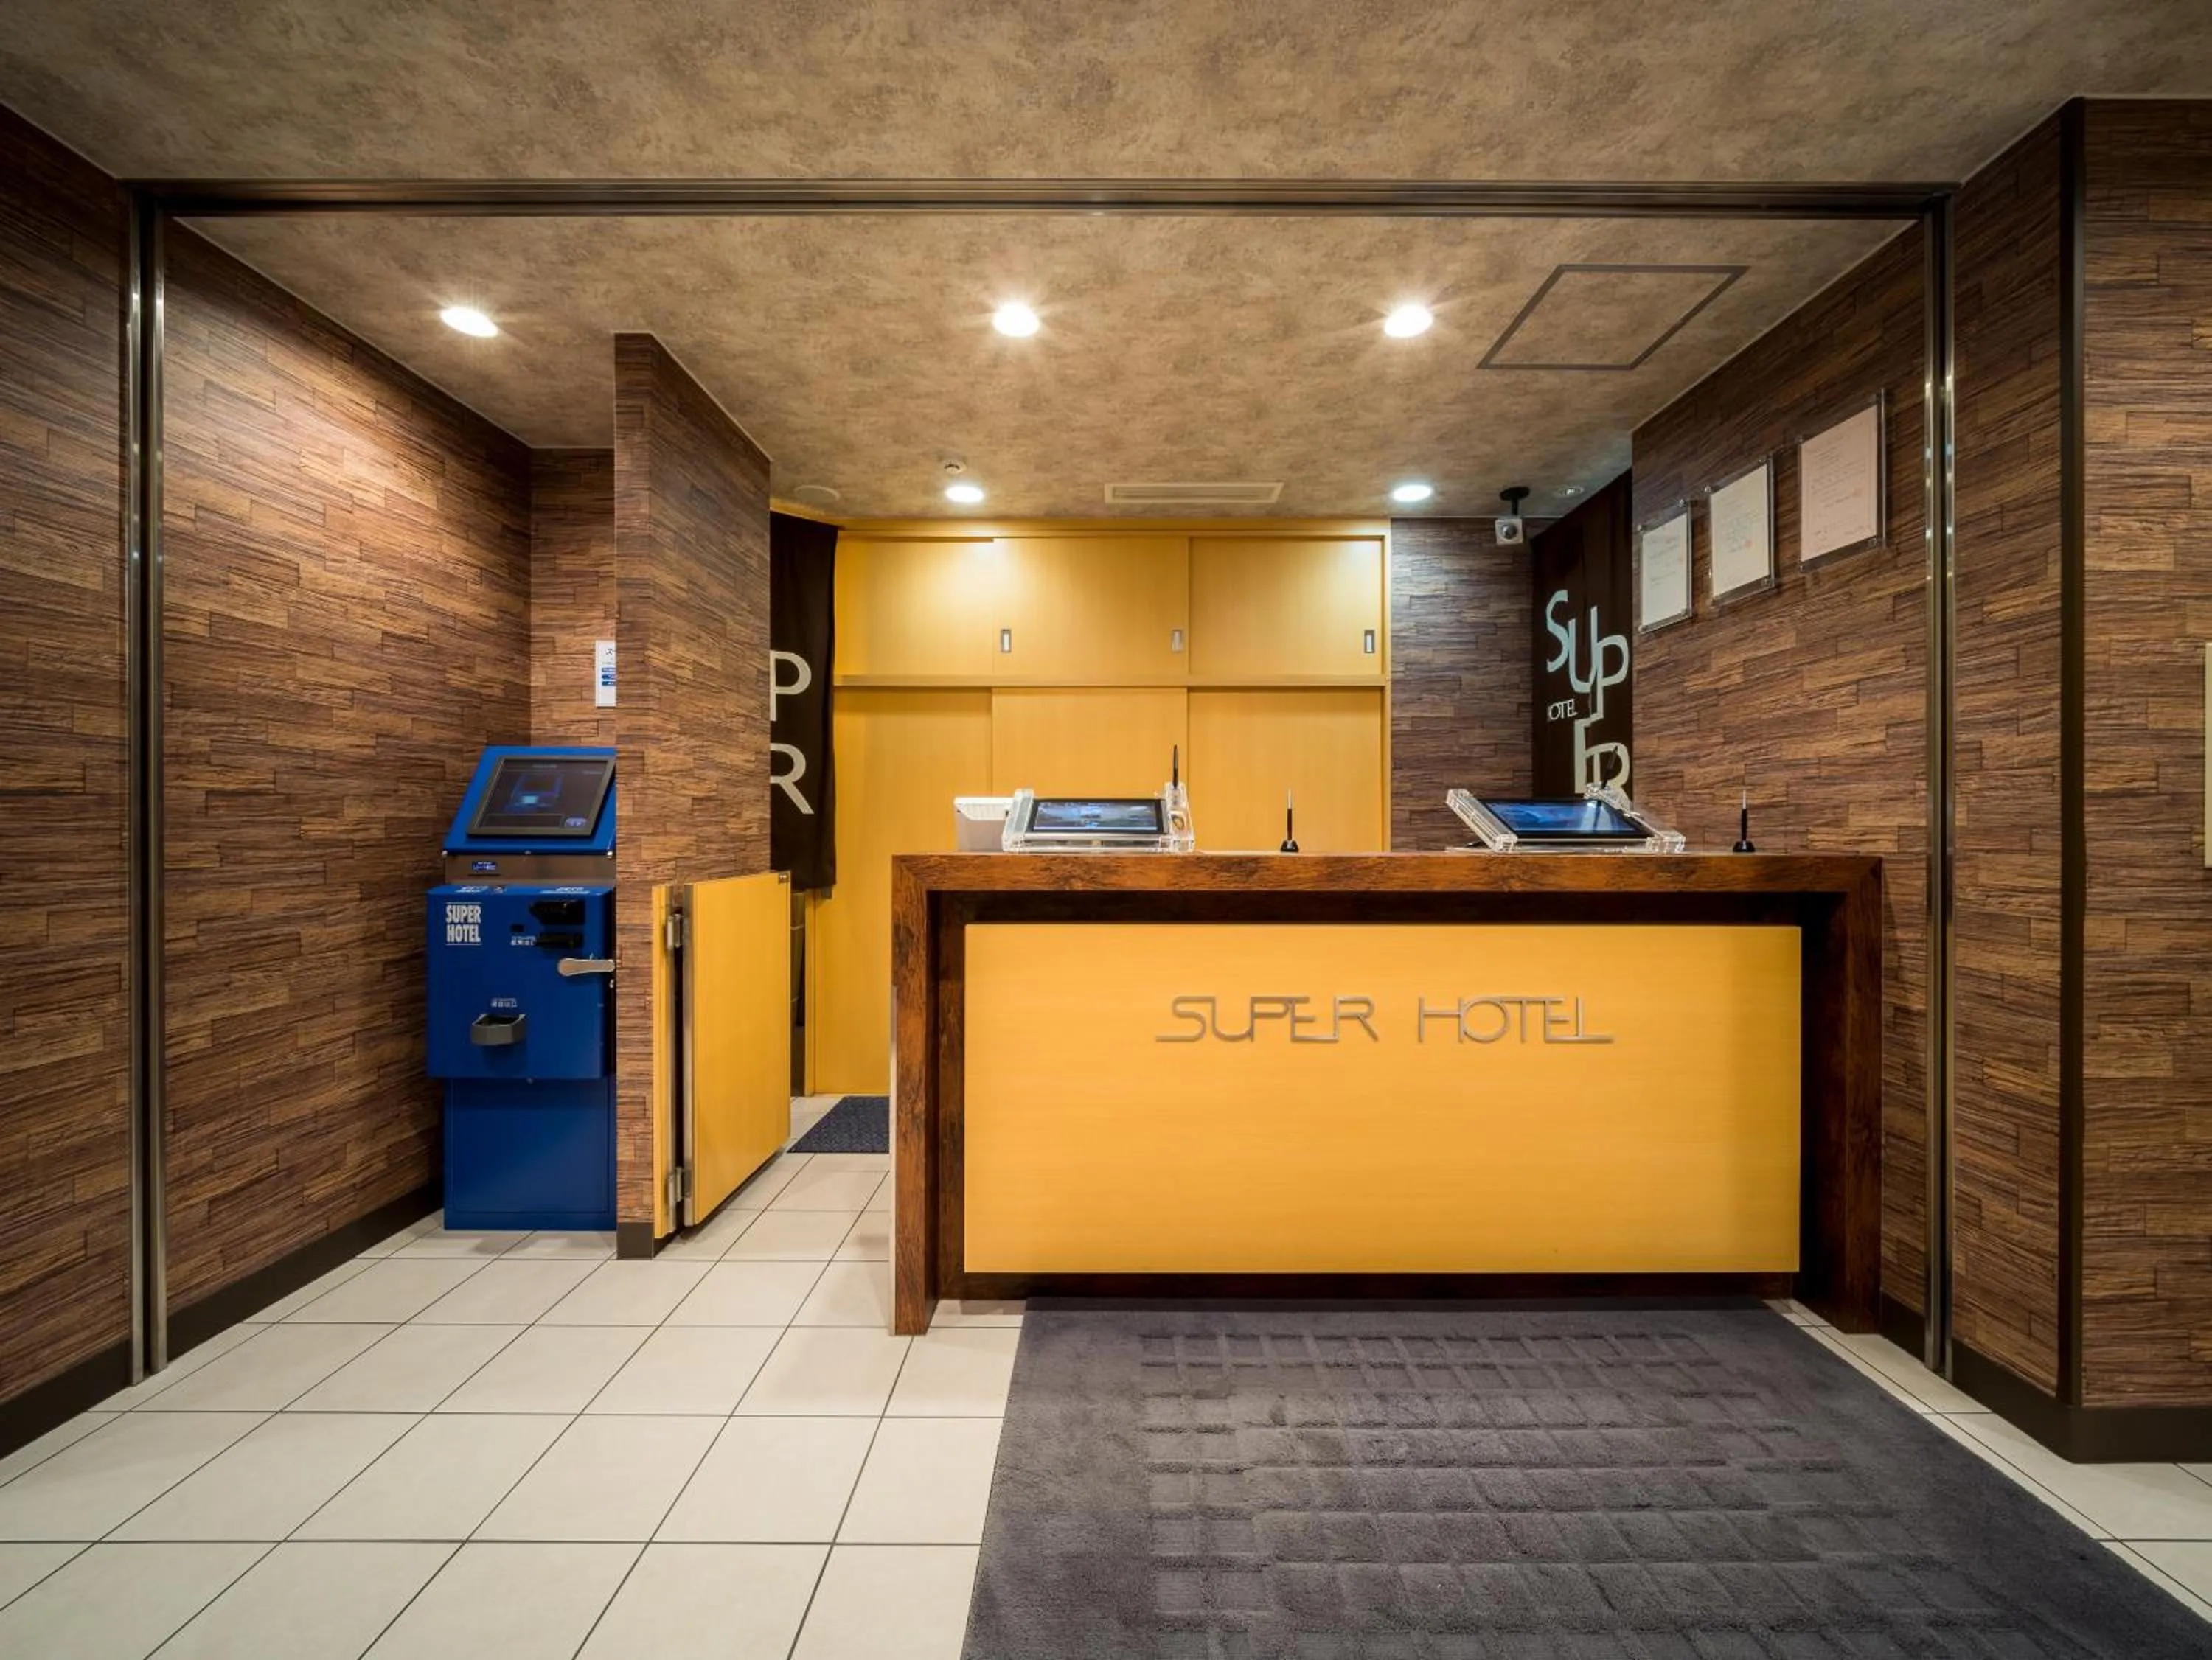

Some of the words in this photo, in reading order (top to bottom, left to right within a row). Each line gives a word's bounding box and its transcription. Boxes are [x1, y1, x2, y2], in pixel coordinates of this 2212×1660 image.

[1548, 699, 1578, 722] OTEL
[446, 904, 481, 924] SUPER
[447, 925, 481, 943] HOTEL
[1155, 996, 1378, 1044] SUPER
[1418, 996, 1614, 1044] HOTEL
